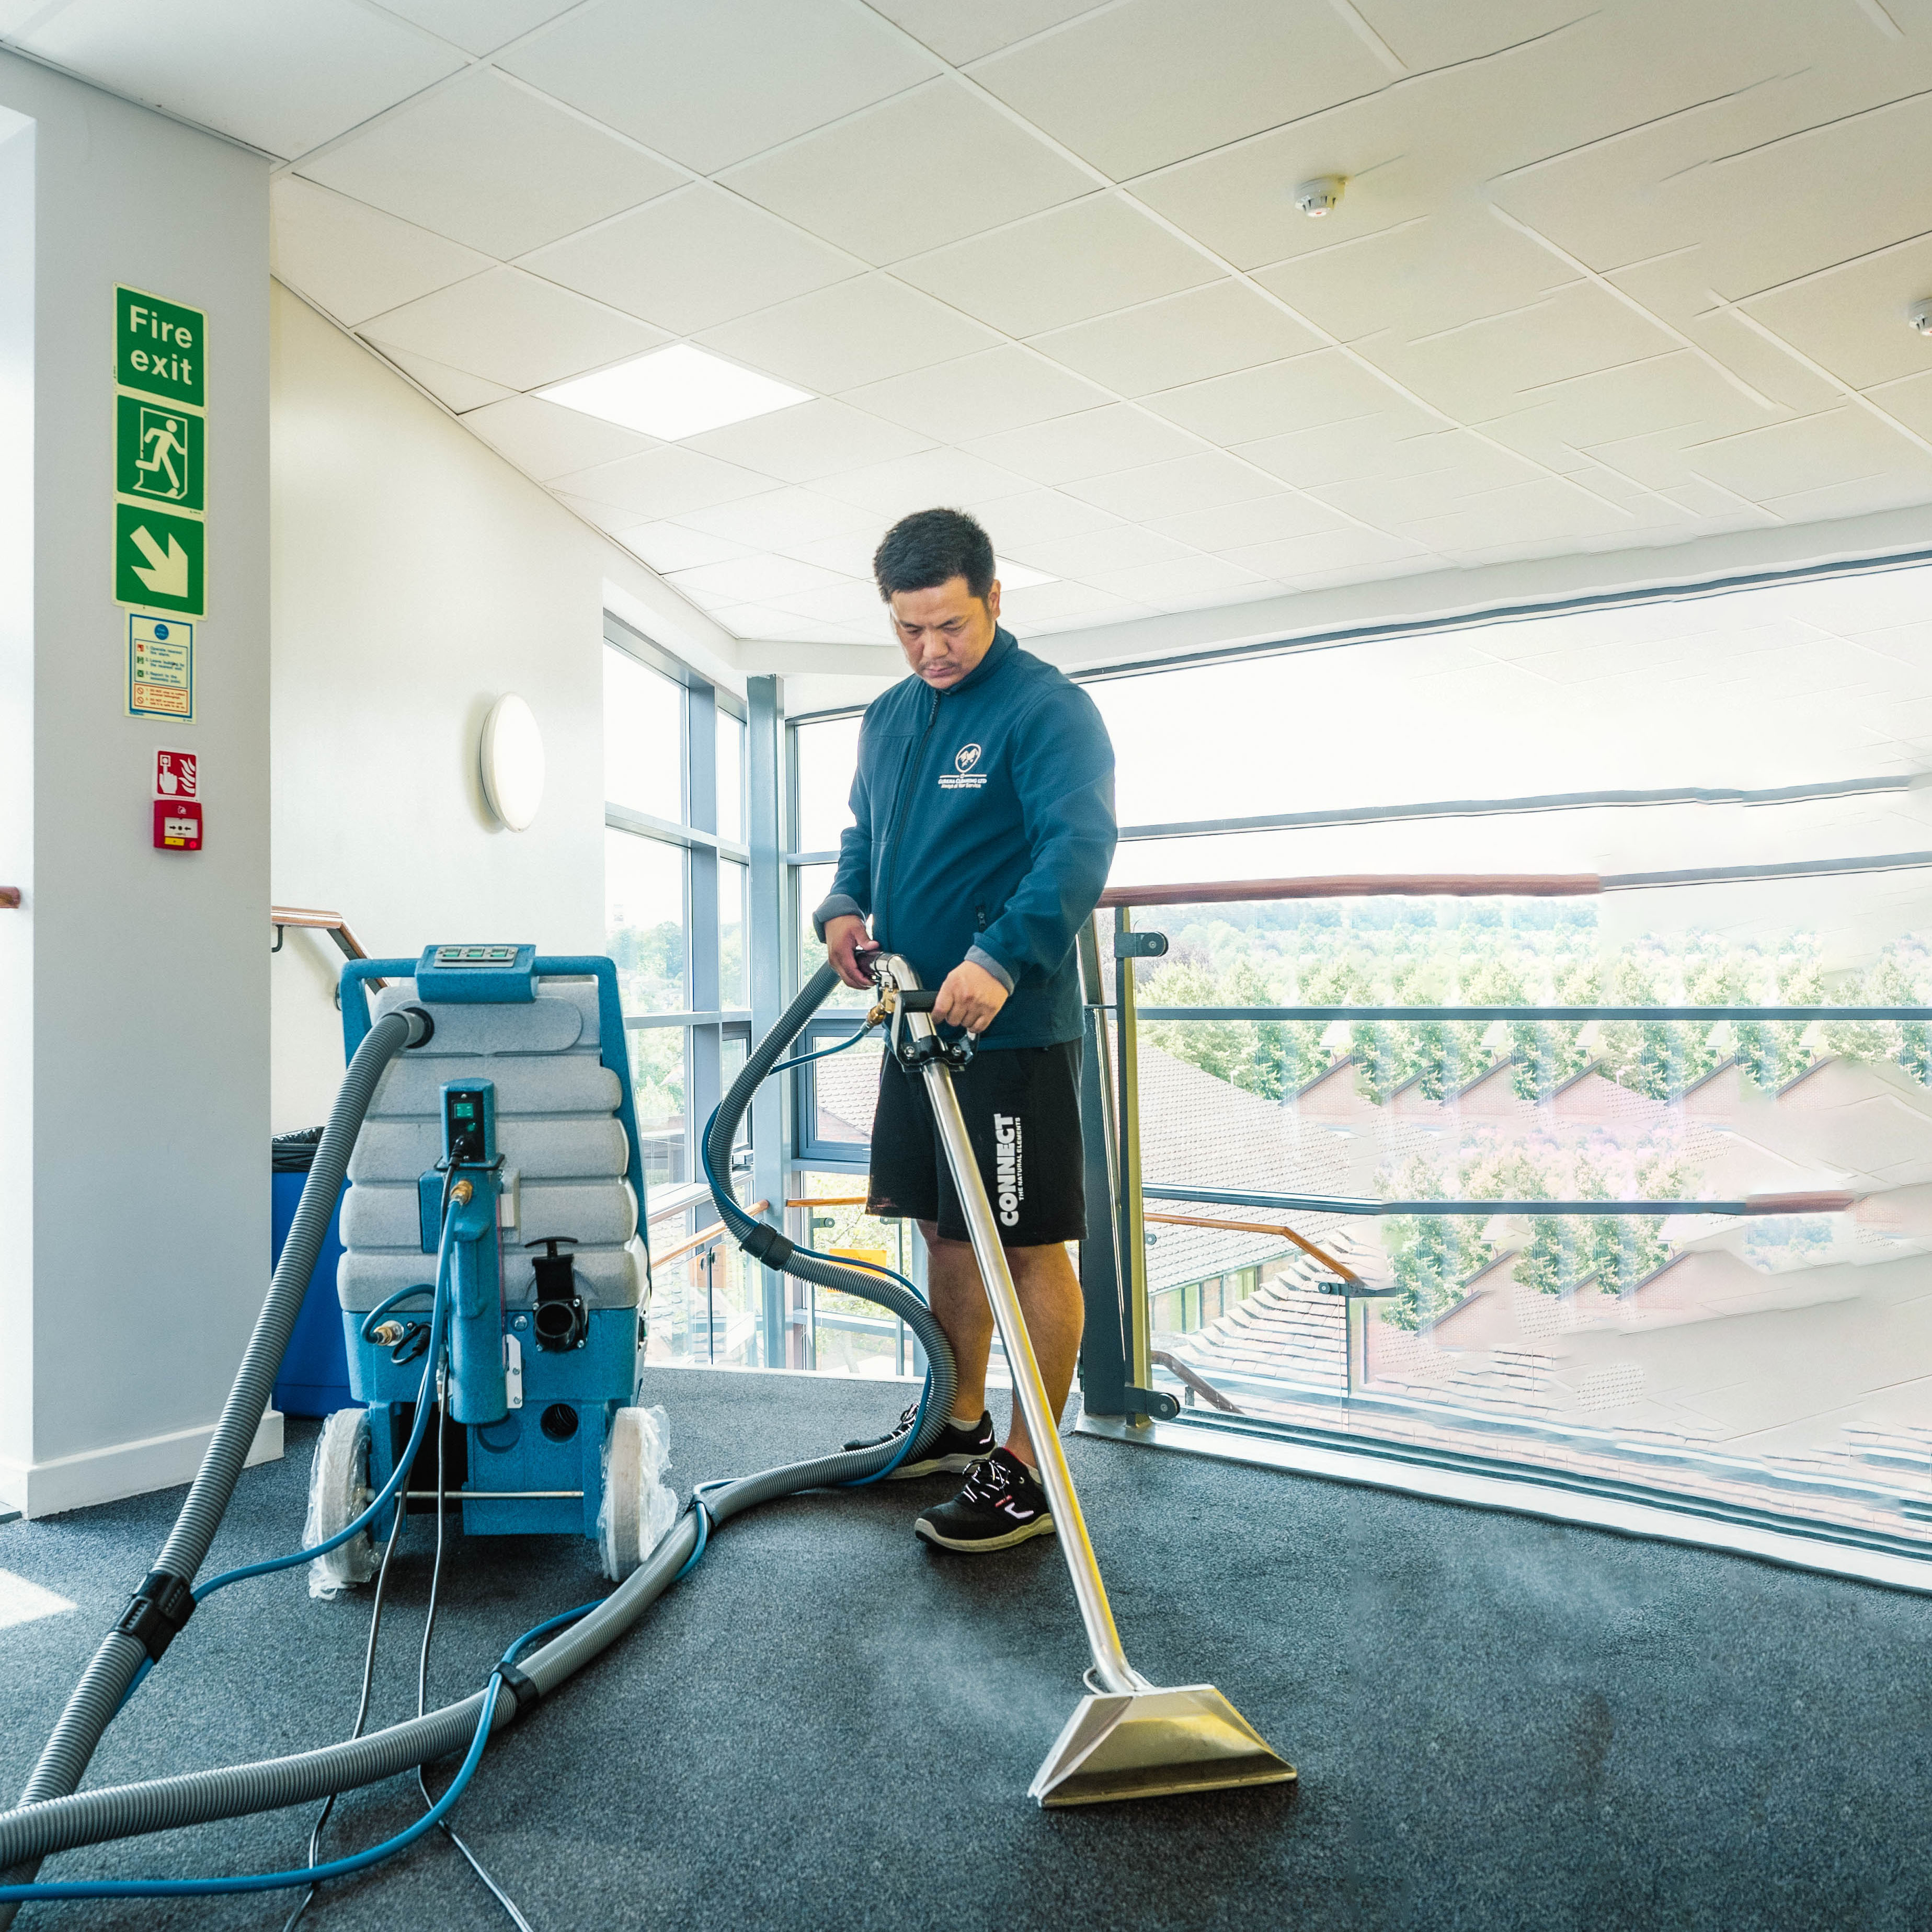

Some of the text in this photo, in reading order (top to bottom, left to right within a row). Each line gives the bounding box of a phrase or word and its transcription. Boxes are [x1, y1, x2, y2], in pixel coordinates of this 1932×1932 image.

[130, 305, 192, 348] Fire
[131, 350, 192, 385] exit
[993, 1113, 1019, 1227] CONNECT
